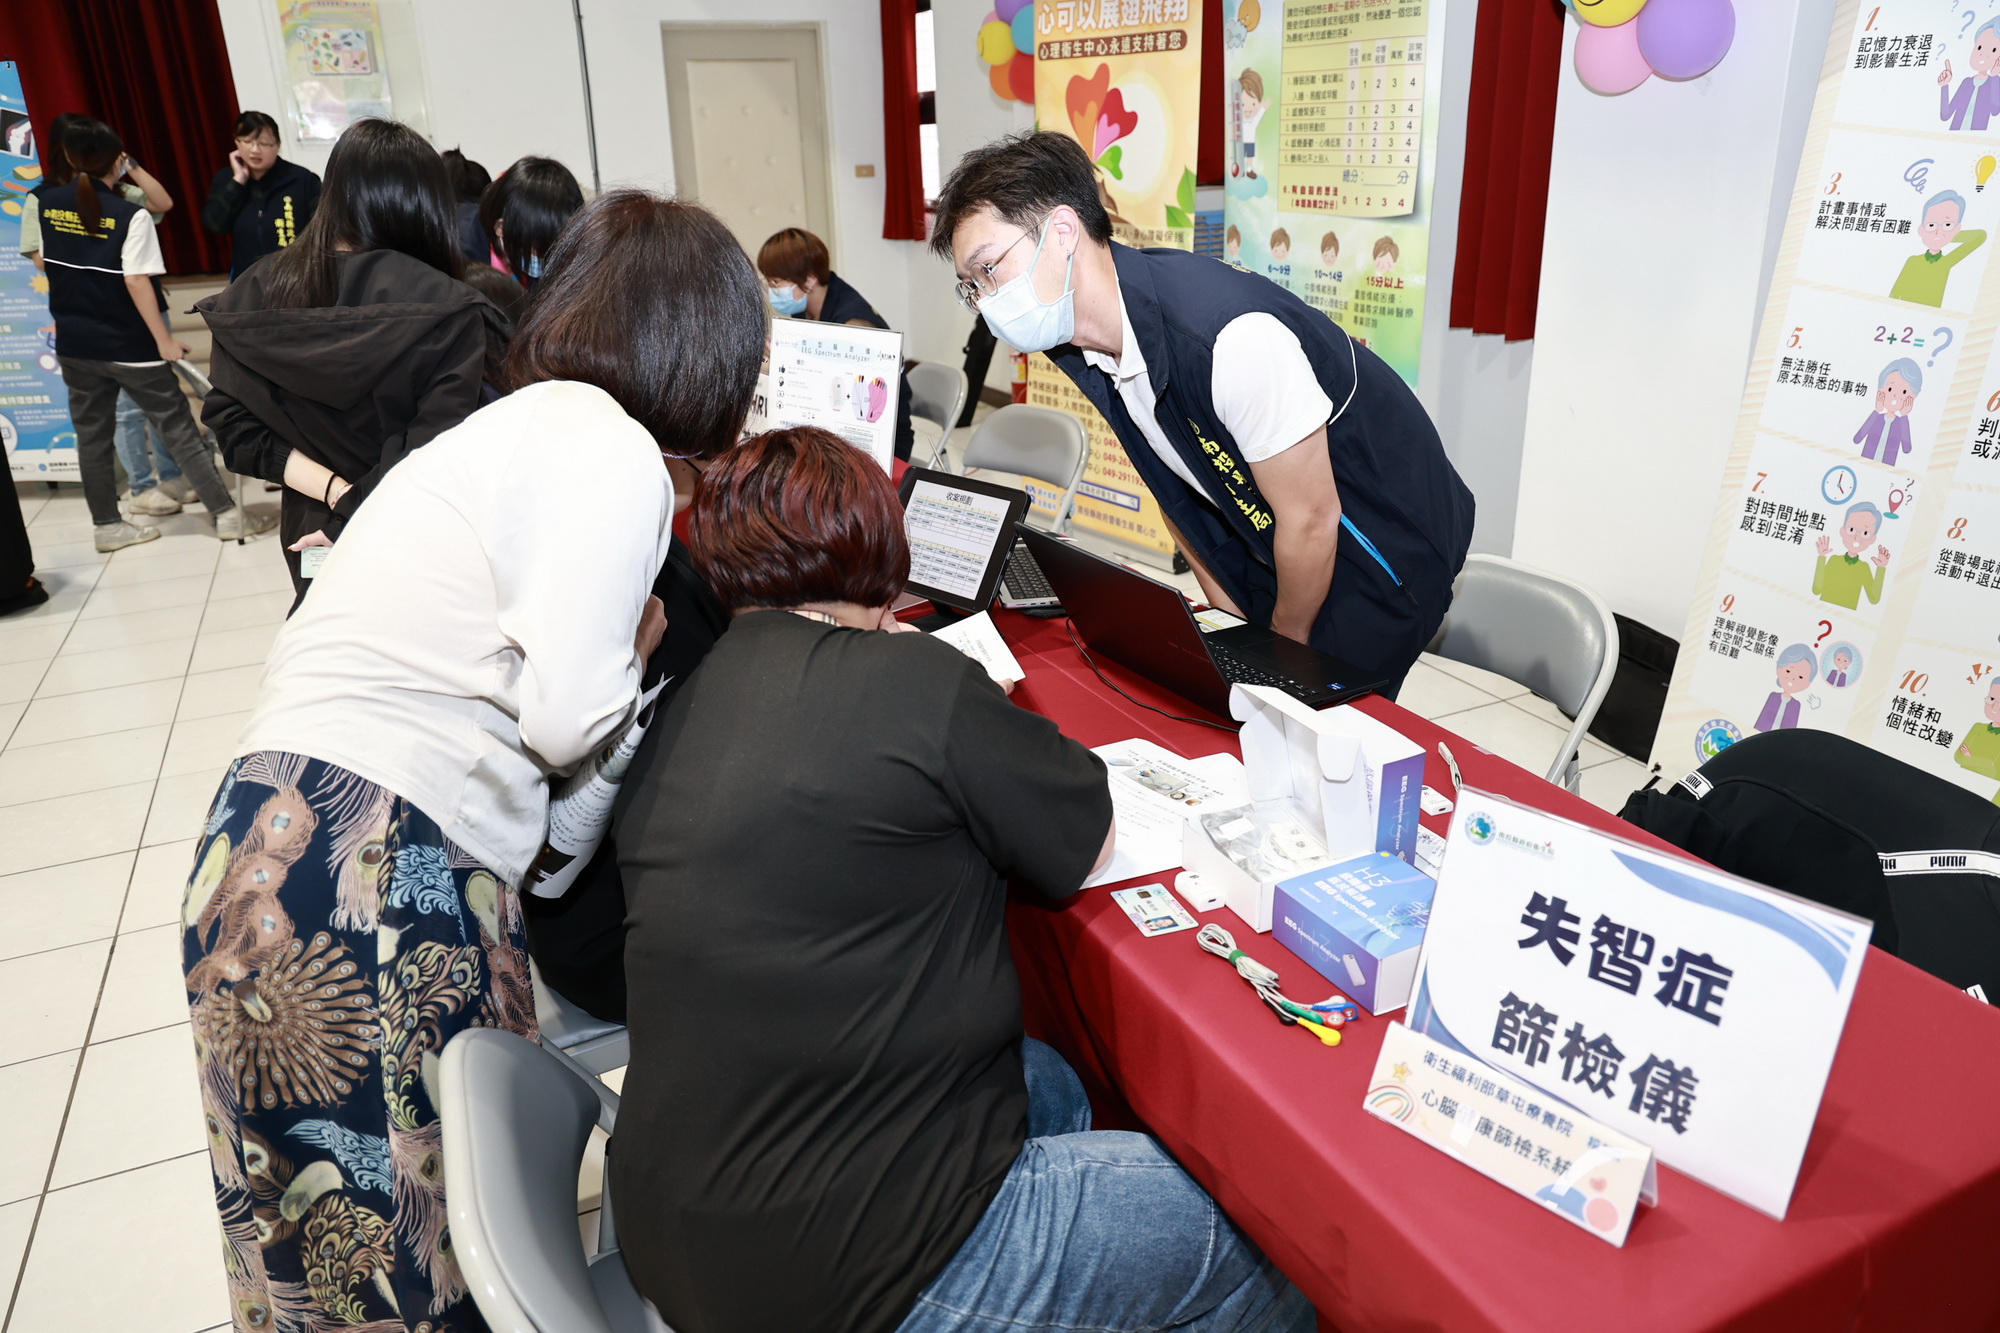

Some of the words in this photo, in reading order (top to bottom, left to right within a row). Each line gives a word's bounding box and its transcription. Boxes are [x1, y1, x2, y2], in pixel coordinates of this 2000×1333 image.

[1864, 6, 1881, 32] 1.
[1858, 34, 1933, 52] 記憶力衰退
[1854, 51, 1928, 70] 到影響生活
[1397, 170, 1409, 185] 分
[1824, 172, 1842, 196] 3.
[1818, 200, 1887, 218] 計畫事情或
[1814, 215, 1912, 235] 解決問題有困難
[1366, 276, 1404, 290] 15分以上
[1786, 326, 1804, 350] 5.
[815, 349, 841, 359] Spectrum
[845, 352, 870, 362] Analyzer
[1781, 356, 1832, 376] 無法勝任
[1776, 370, 1868, 397] 原本熟悉的事物
[1752, 472, 1768, 494] 7.
[946, 492, 974, 506] 收案規劃
[1744, 497, 1826, 532] 對時間地點
[1740, 515, 1805, 546] 感到混淆
[1947, 517, 1966, 543] 8.
[1719, 594, 1734, 616] 9.
[1715, 616, 1778, 648] 理解視覺影像
[1708, 640, 1740, 660] 有困難
[1711, 629, 1776, 660] 和空間之關係
[1898, 670, 1930, 698] 10.
[1891, 696, 1942, 725] 情緒和
[1886, 713, 1954, 750] 個性改變
[1930, 856, 1966, 868] PUMA
[1353, 866, 1392, 888] H3
[1315, 880, 1338, 896] EEG
[1334, 890, 1368, 918] Spectrum
[1367, 916, 1401, 941] Analyzer
[1284, 916, 1298, 932] EEG
[1297, 927, 1319, 949] Spectrum
[1517, 891, 1734, 1026] 失智症
[1491, 992, 1700, 1136] 篩檢儀
[1424, 1050, 1573, 1138] 衛生福利部草屯療養院
